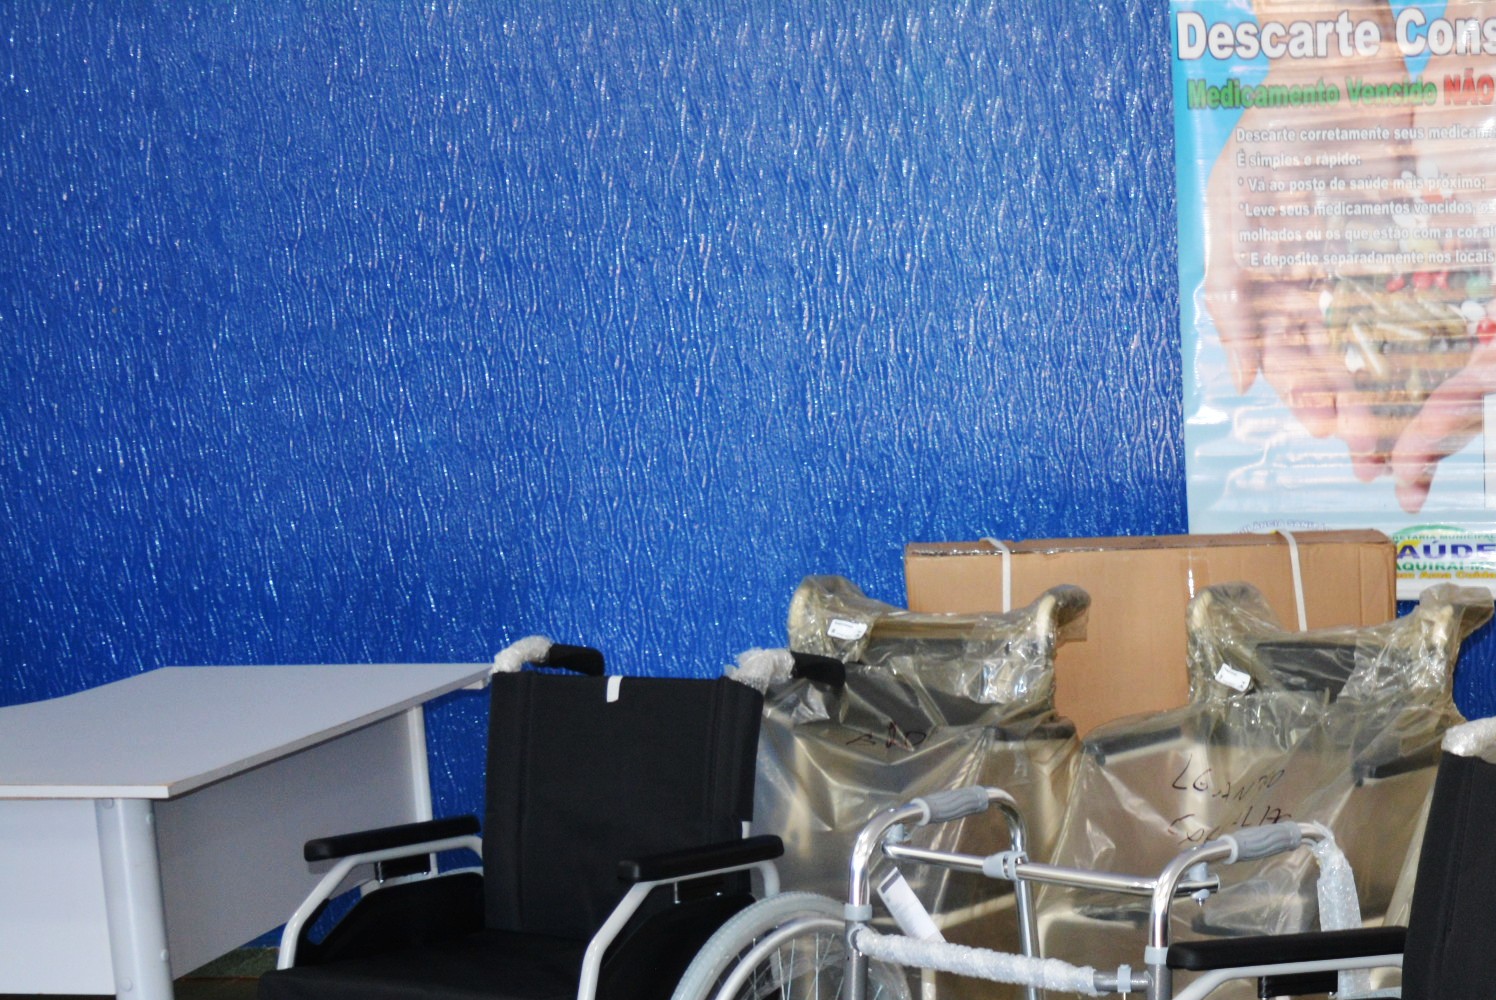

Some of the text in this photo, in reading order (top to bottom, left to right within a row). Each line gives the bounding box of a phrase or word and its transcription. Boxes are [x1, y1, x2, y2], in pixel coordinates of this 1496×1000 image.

[1176, 10, 1381, 60] Descarte
[1186, 77, 1341, 110] Medicamento
[1346, 74, 1438, 107] Vencido
[1443, 67, 1495, 105] NÃO
[1236, 127, 1296, 142] Descarte
[1299, 127, 1390, 141] corretamente
[1394, 127, 1425, 140] seus
[1236, 149, 1245, 168] É
[1249, 152, 1300, 171] simples
[1304, 155, 1312, 167] e
[1248, 177, 1266, 191] Vá
[1270, 179, 1285, 191] ao
[1289, 177, 1326, 194] posto
[1329, 175, 1345, 190] de
[1351, 175, 1388, 190] saúde
[1392, 175, 1424, 189] mais
[1279, 204, 1310, 216] seus
[1313, 201, 1410, 215] medicamentos
[1239, 226, 1302, 243] molhados
[1306, 230, 1322, 242] ou
[1325, 229, 1341, 241] os
[1345, 228, 1369, 244] que
[1413, 226, 1441, 239] com
[1445, 226, 1453, 239] a
[1457, 225, 1479, 239] cor
[1250, 251, 1260, 267] E
[1263, 251, 1320, 269] deposite
[1323, 249, 1425, 267] separadamente
[1428, 251, 1452, 263] nos
[1455, 248, 1495, 263] locais
[1396, 540, 1496, 559] AÚDE
